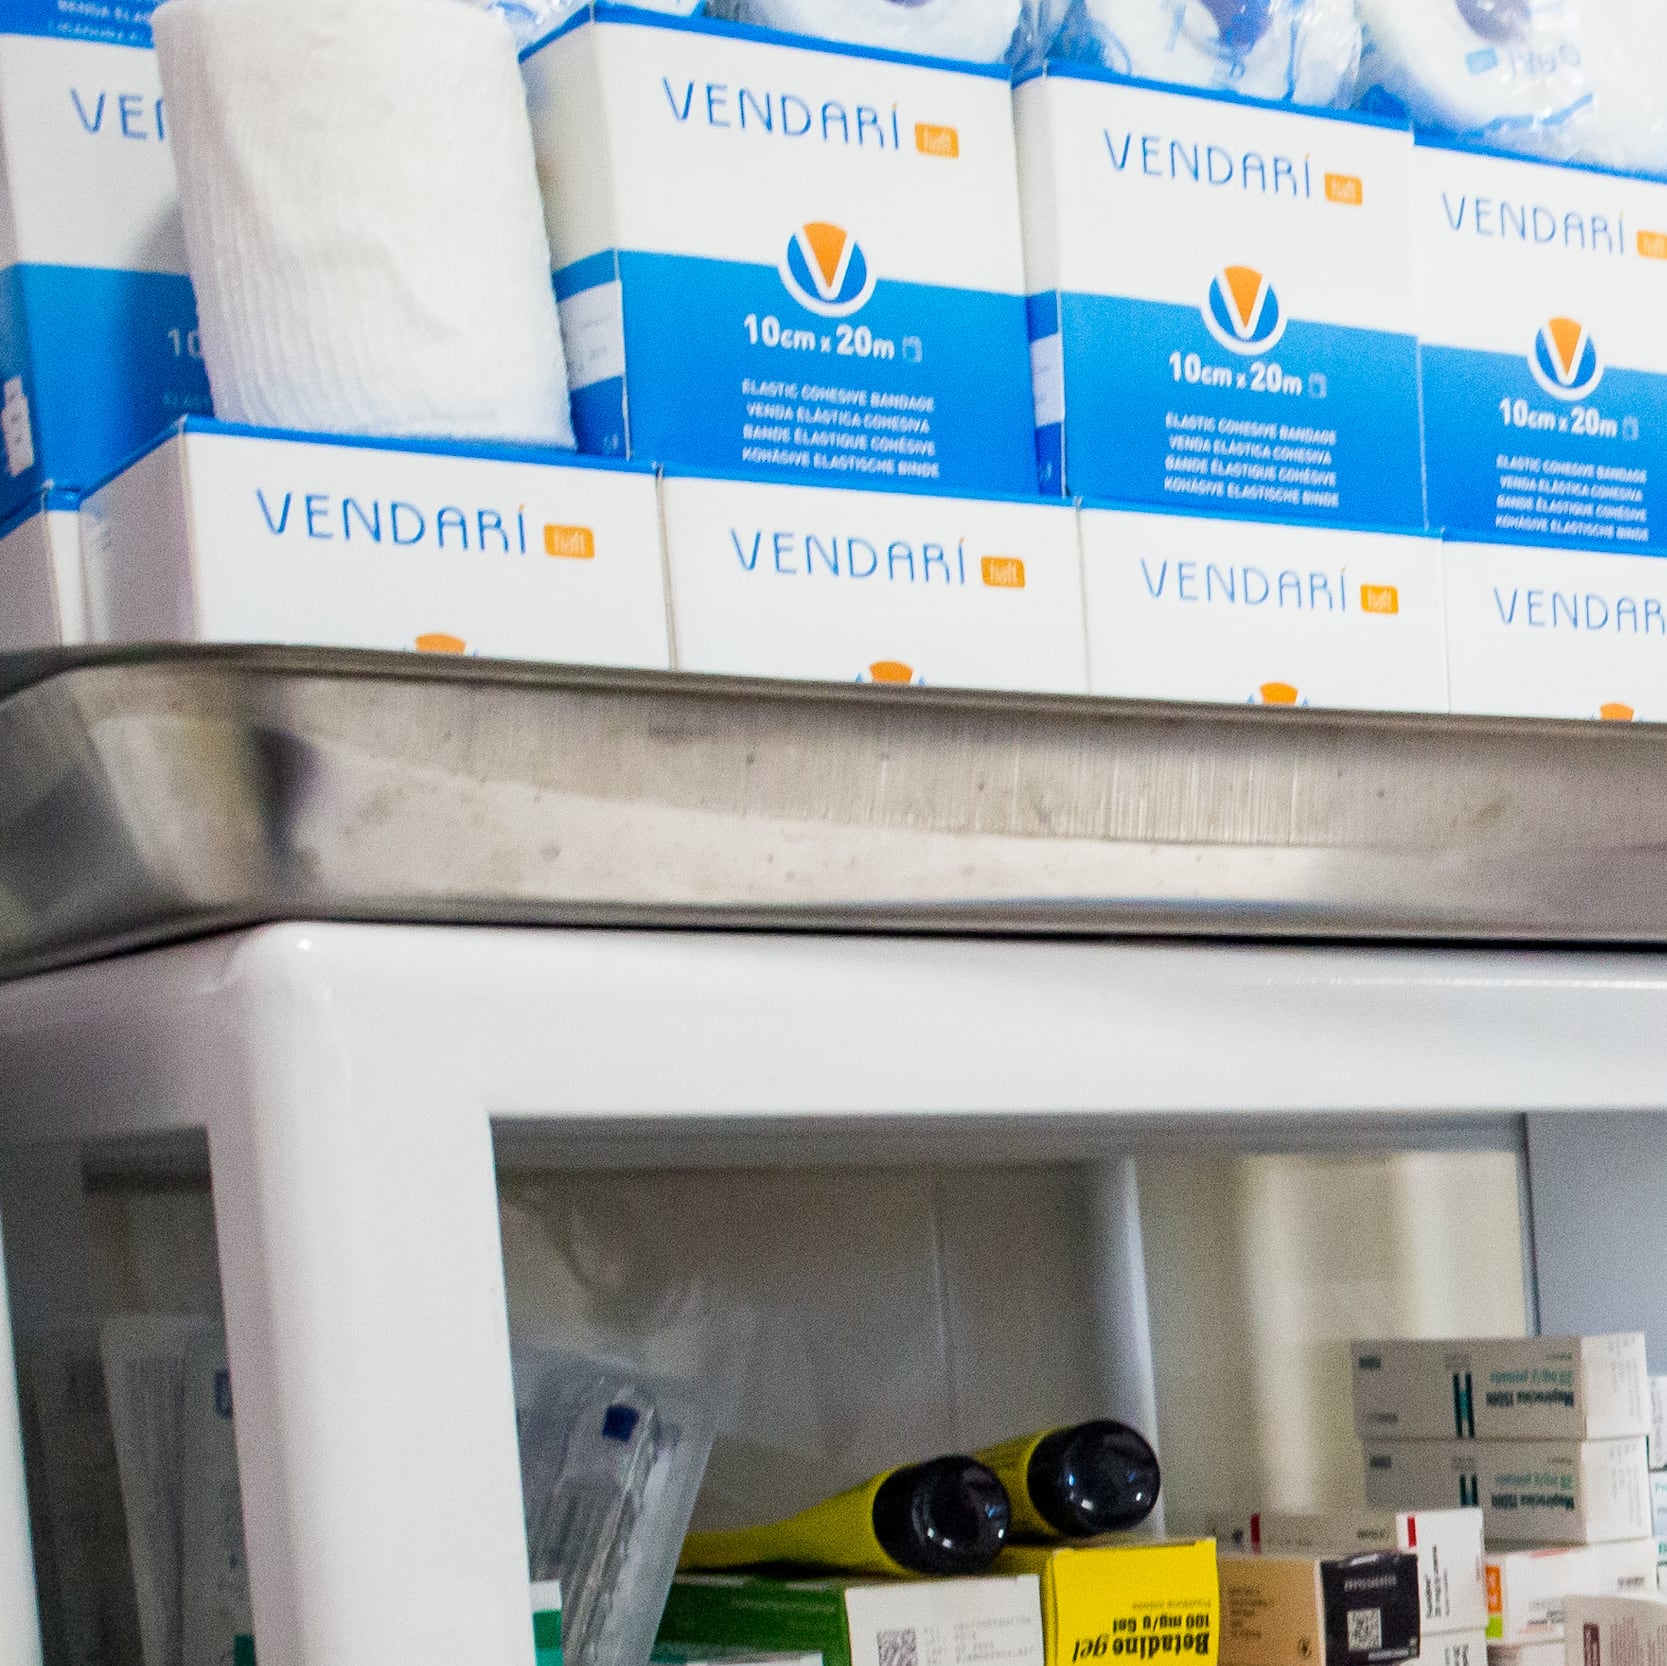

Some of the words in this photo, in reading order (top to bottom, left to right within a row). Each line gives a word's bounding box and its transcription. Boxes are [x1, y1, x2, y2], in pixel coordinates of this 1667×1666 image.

[663, 77, 900, 150] VENDARÍ
[1104, 129, 1310, 198] VENDARÍ
[1443, 191, 1624, 255] VENDARÍ
[744, 313, 815, 352] 10cm
[836, 324, 895, 360] 20m
[1169, 351, 1232, 387] 10cm
[1251, 362, 1301, 395] 20m
[1500, 397, 1555, 428] 10cm
[1571, 406, 1617, 438] 20m
[255, 487, 528, 556] VENDARÍ
[731, 528, 966, 585] VENDARÍ
[1142, 557, 1347, 612] VENDARÍ
[1072, 1632, 1109, 1664] gel
[1113, 1633, 1210, 1660] Betadine
